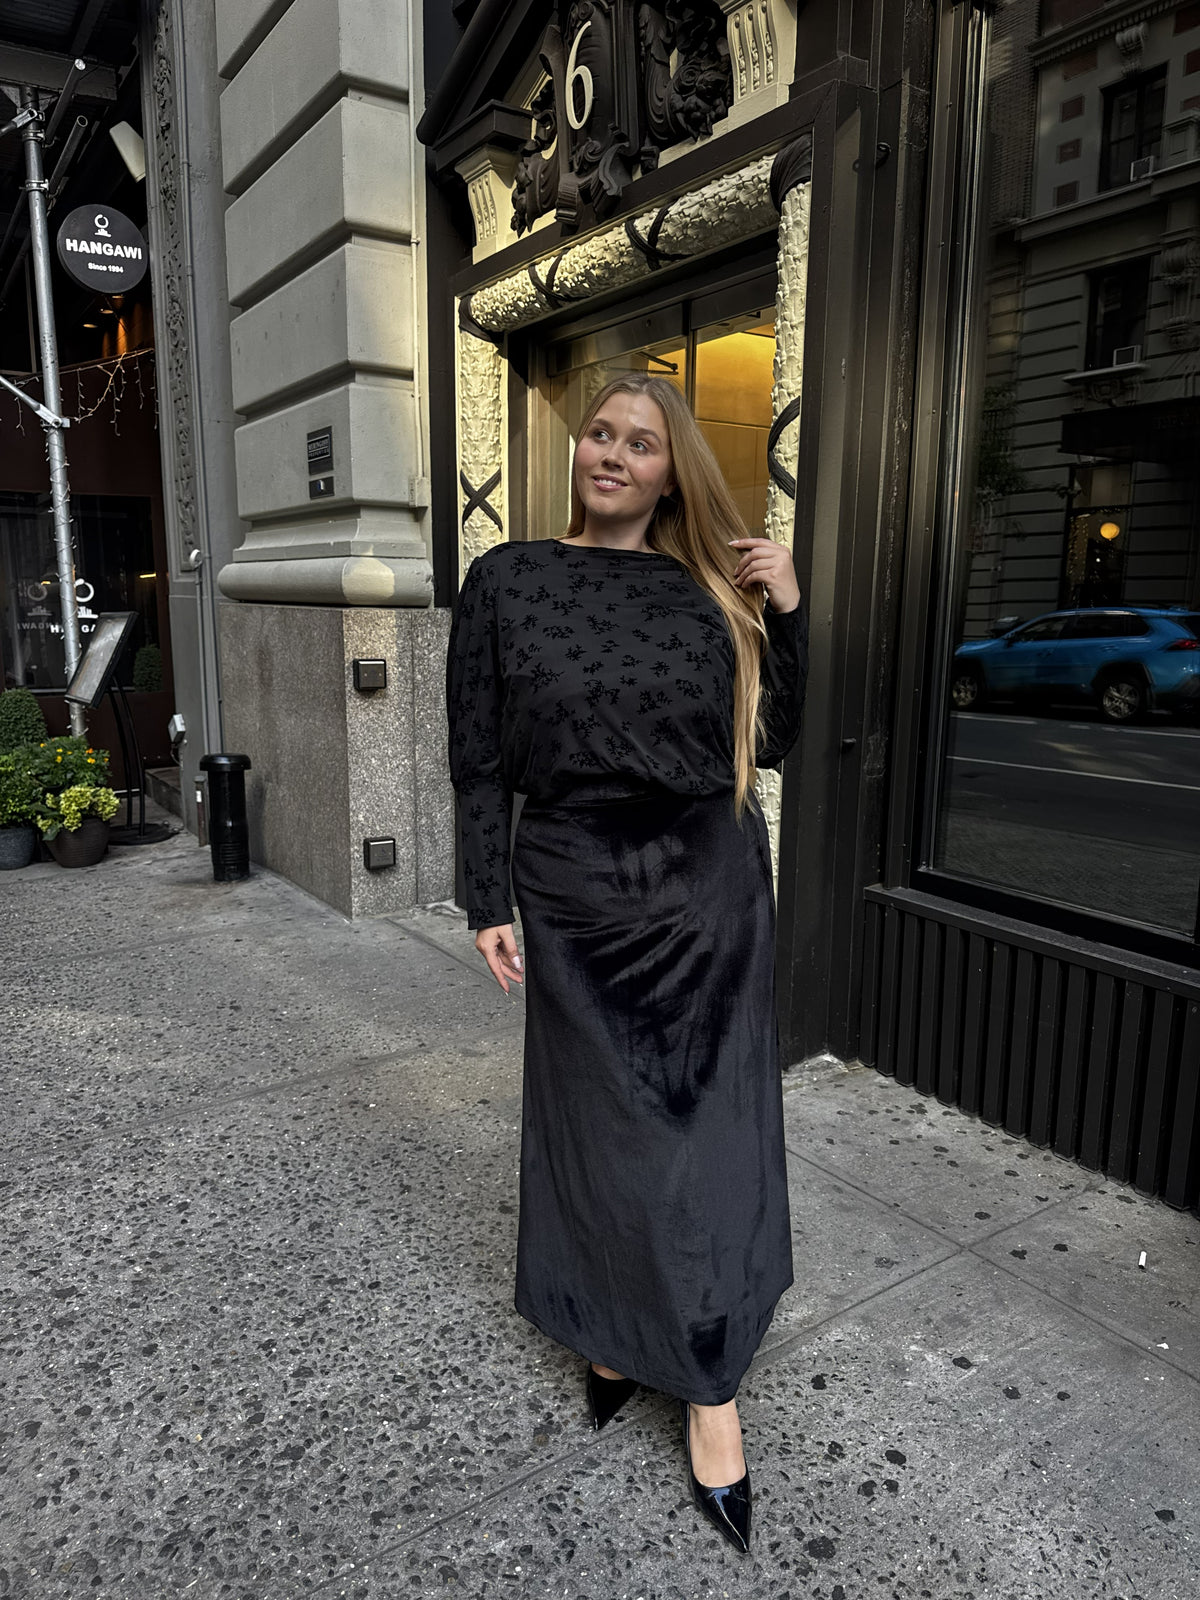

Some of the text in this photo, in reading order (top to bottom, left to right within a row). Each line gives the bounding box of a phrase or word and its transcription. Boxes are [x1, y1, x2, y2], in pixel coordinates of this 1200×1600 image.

[565, 21, 593, 130] 6
[65, 238, 142, 259] HANGAWI
[87, 262, 124, 273] Since 1994
